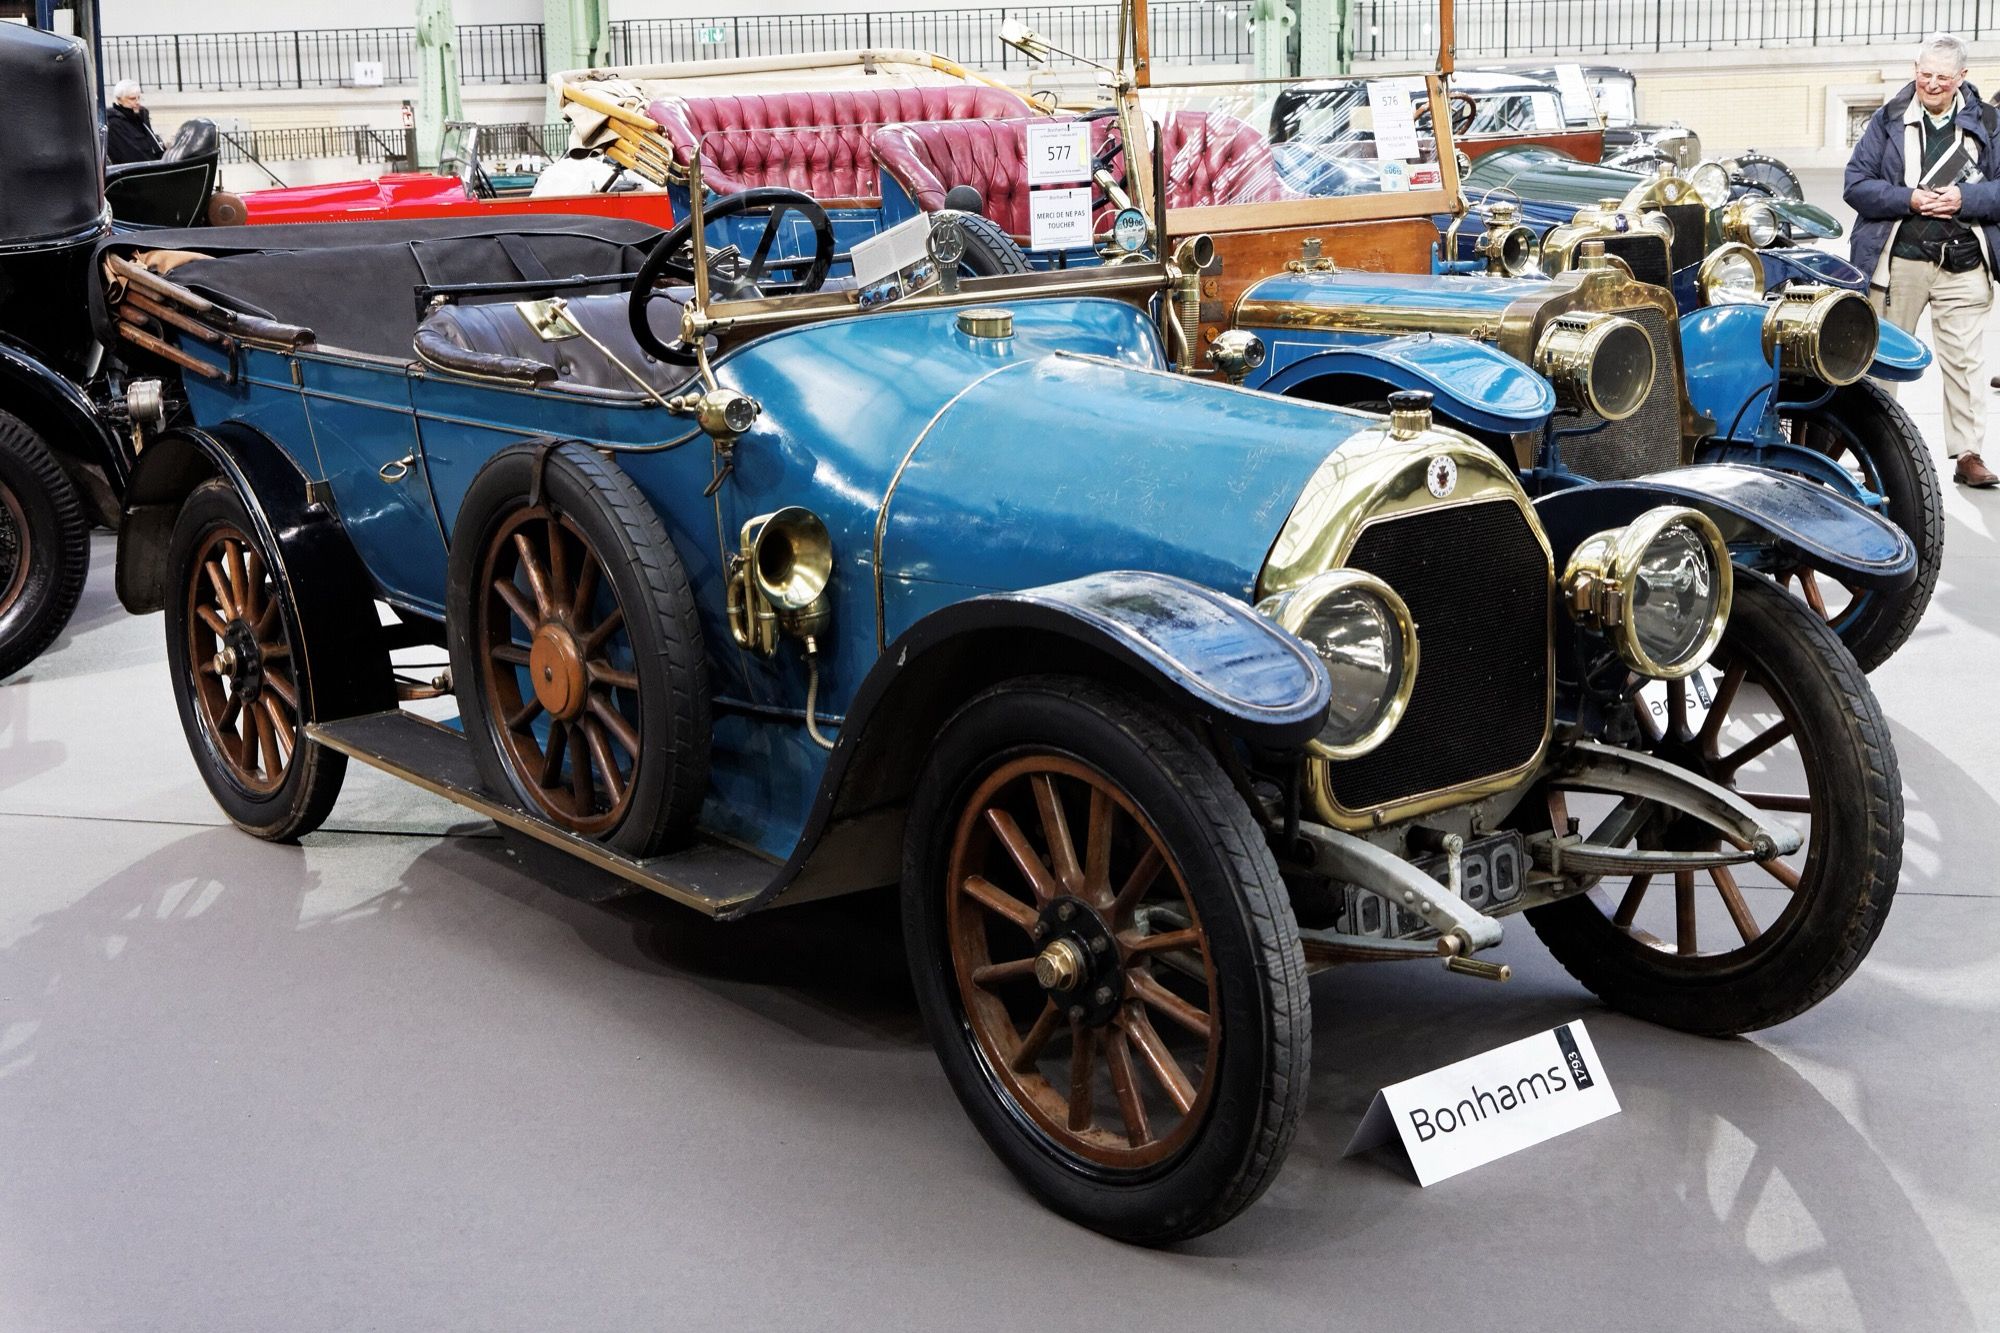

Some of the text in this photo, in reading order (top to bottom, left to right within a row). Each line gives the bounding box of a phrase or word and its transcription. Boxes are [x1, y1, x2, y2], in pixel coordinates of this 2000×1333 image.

[1382, 96, 1398, 107] 576
[1047, 145, 1071, 161] 577
[1037, 212, 1055, 220] MERCI
[1065, 210, 1073, 218] NE
[1074, 209, 1086, 217] PAS
[1048, 221, 1075, 229] TOUCHER
[1122, 216, 1134, 228] 09
[1409, 1051, 1588, 1142] Bonhams 1793
